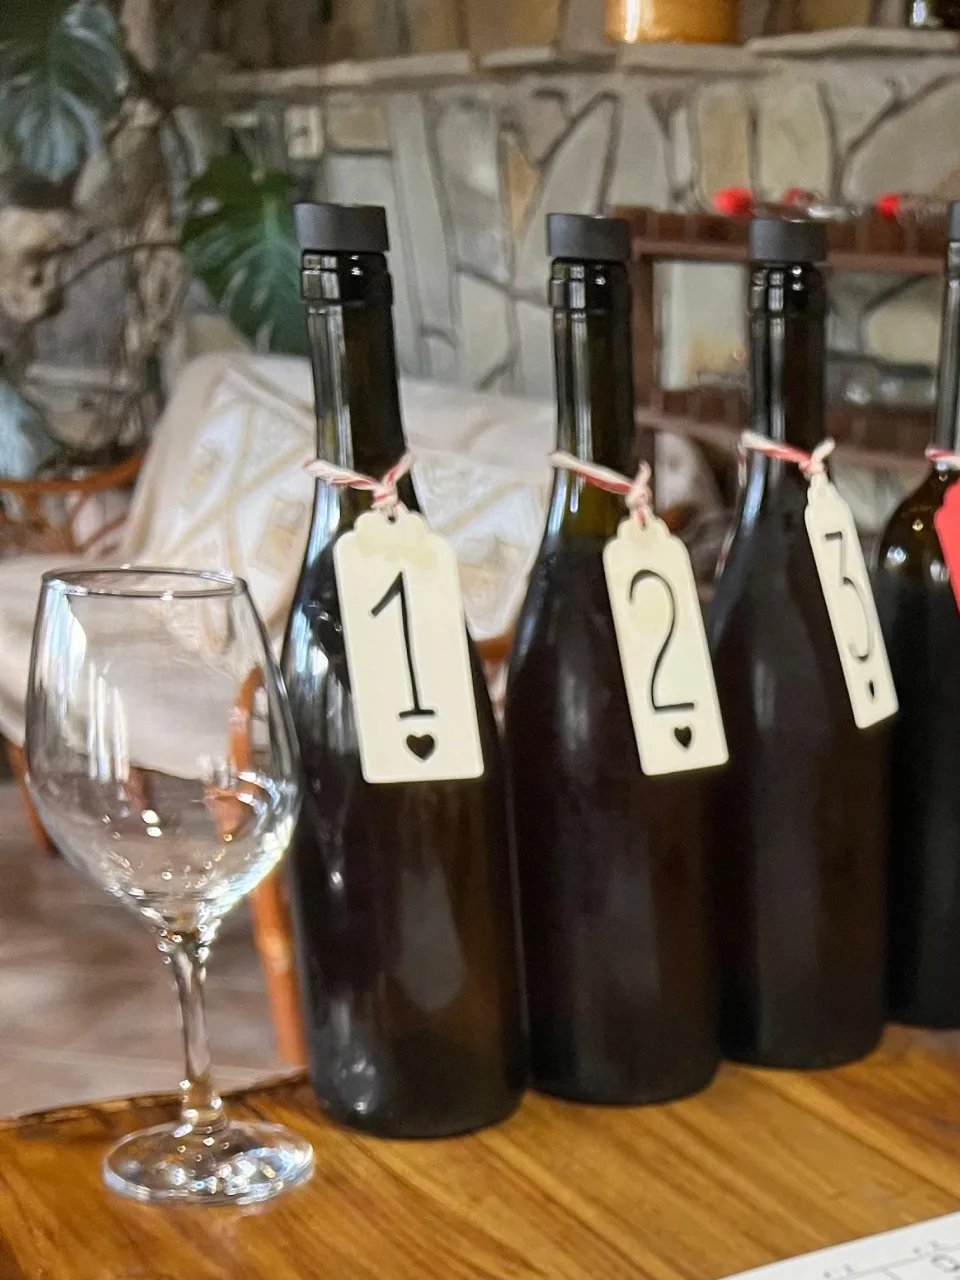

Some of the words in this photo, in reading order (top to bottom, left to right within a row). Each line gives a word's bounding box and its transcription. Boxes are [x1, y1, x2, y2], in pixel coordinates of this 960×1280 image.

[370, 570, 437, 720] 1
[628, 568, 697, 714] 2
[824, 531, 875, 664] 3
